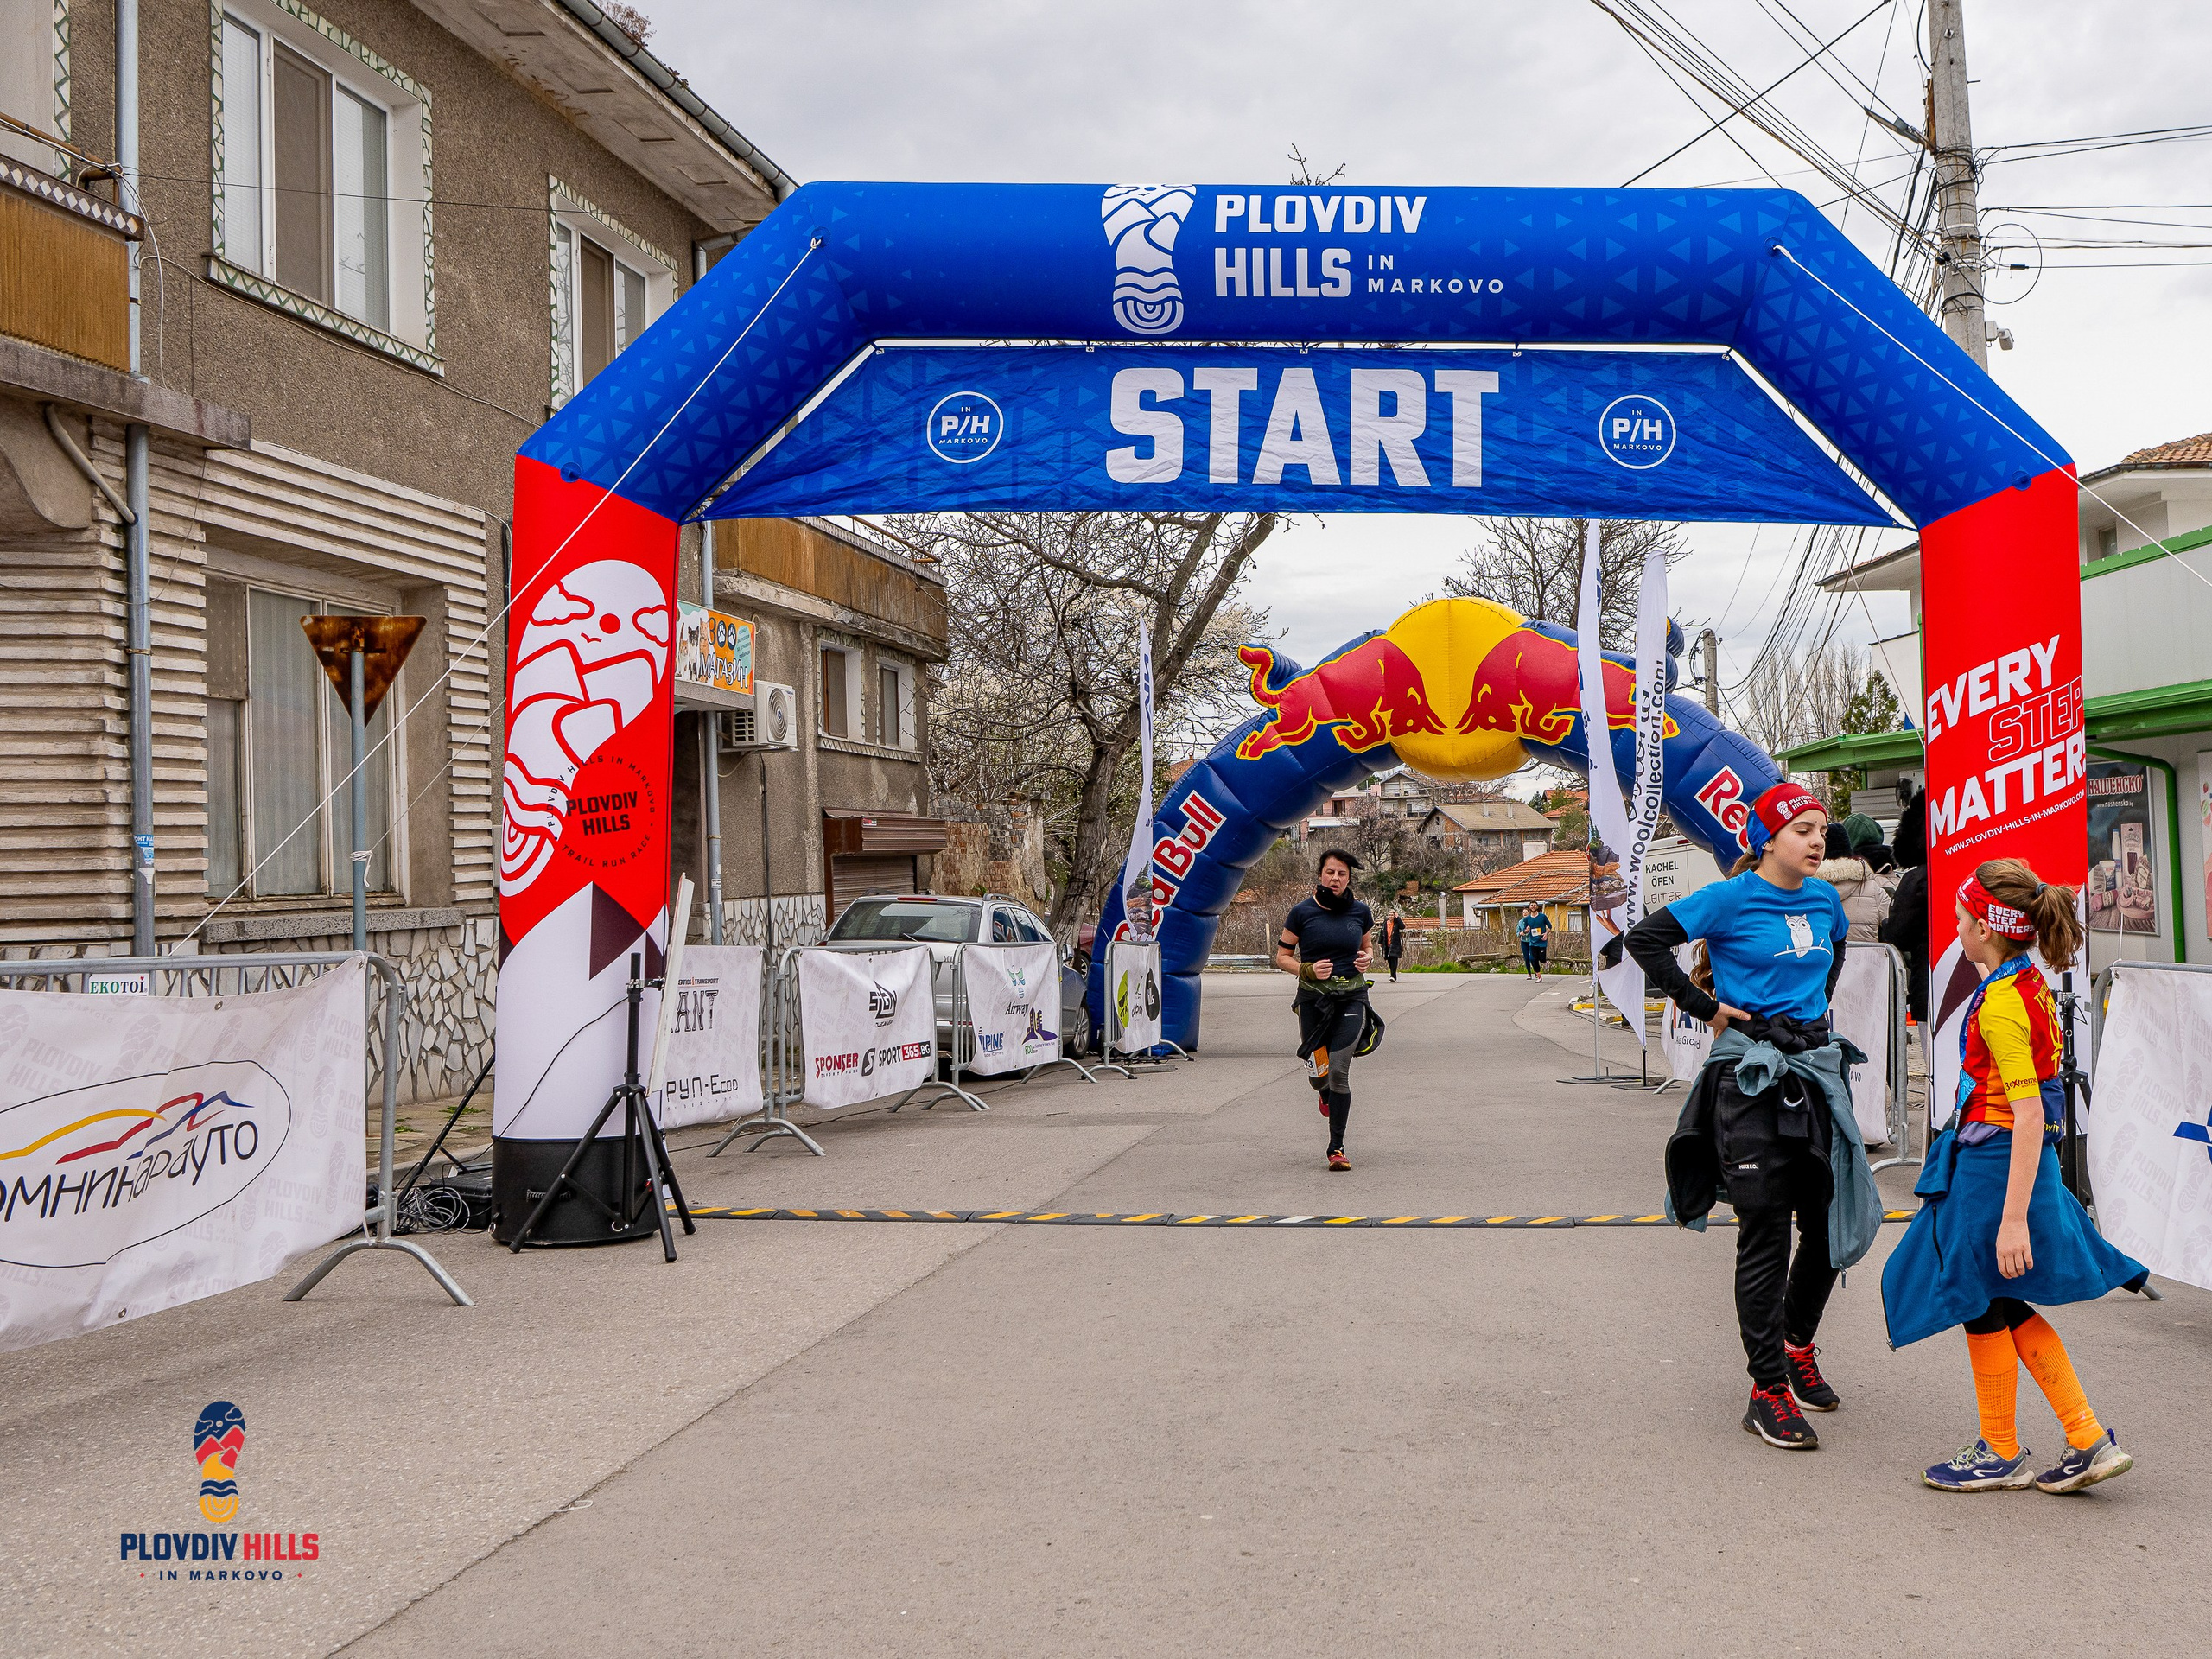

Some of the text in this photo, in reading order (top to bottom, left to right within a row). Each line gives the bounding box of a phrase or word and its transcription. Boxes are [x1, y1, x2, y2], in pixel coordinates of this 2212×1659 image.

[1214, 194, 1427, 234] PLOVDIV
[1214, 247, 1351, 297] HILLS
[1368, 254, 1394, 270] IN
[1367, 278, 1504, 294] MARKOVO
[940, 415, 991, 437] P/H
[1105, 367, 1500, 488] START
[1612, 417, 1662, 442] P/H
[700, 652, 748, 689] МАГАЗИН
[1927, 634, 2061, 746] EVERY
[1987, 675, 2083, 762] STEP
[566, 791, 638, 817] PLOVDIV
[582, 814, 631, 836] HILLS
[1944, 788, 2086, 856] WWW.PLOVDIV-HILLS-IN-MARKOVO.COM
[1152, 791, 1226, 880] Bull
[562, 834, 651, 868] TRAIL RUN RACE
[1645, 861, 1680, 874] KACHEL
[1651, 874, 1675, 887] ÖFEN
[1987, 912, 2017, 925] STEP
[1988, 903, 2025, 918] EVERY
[1004, 1001, 1029, 1018] Airway
[815, 1052, 859, 1079] SPONSER
